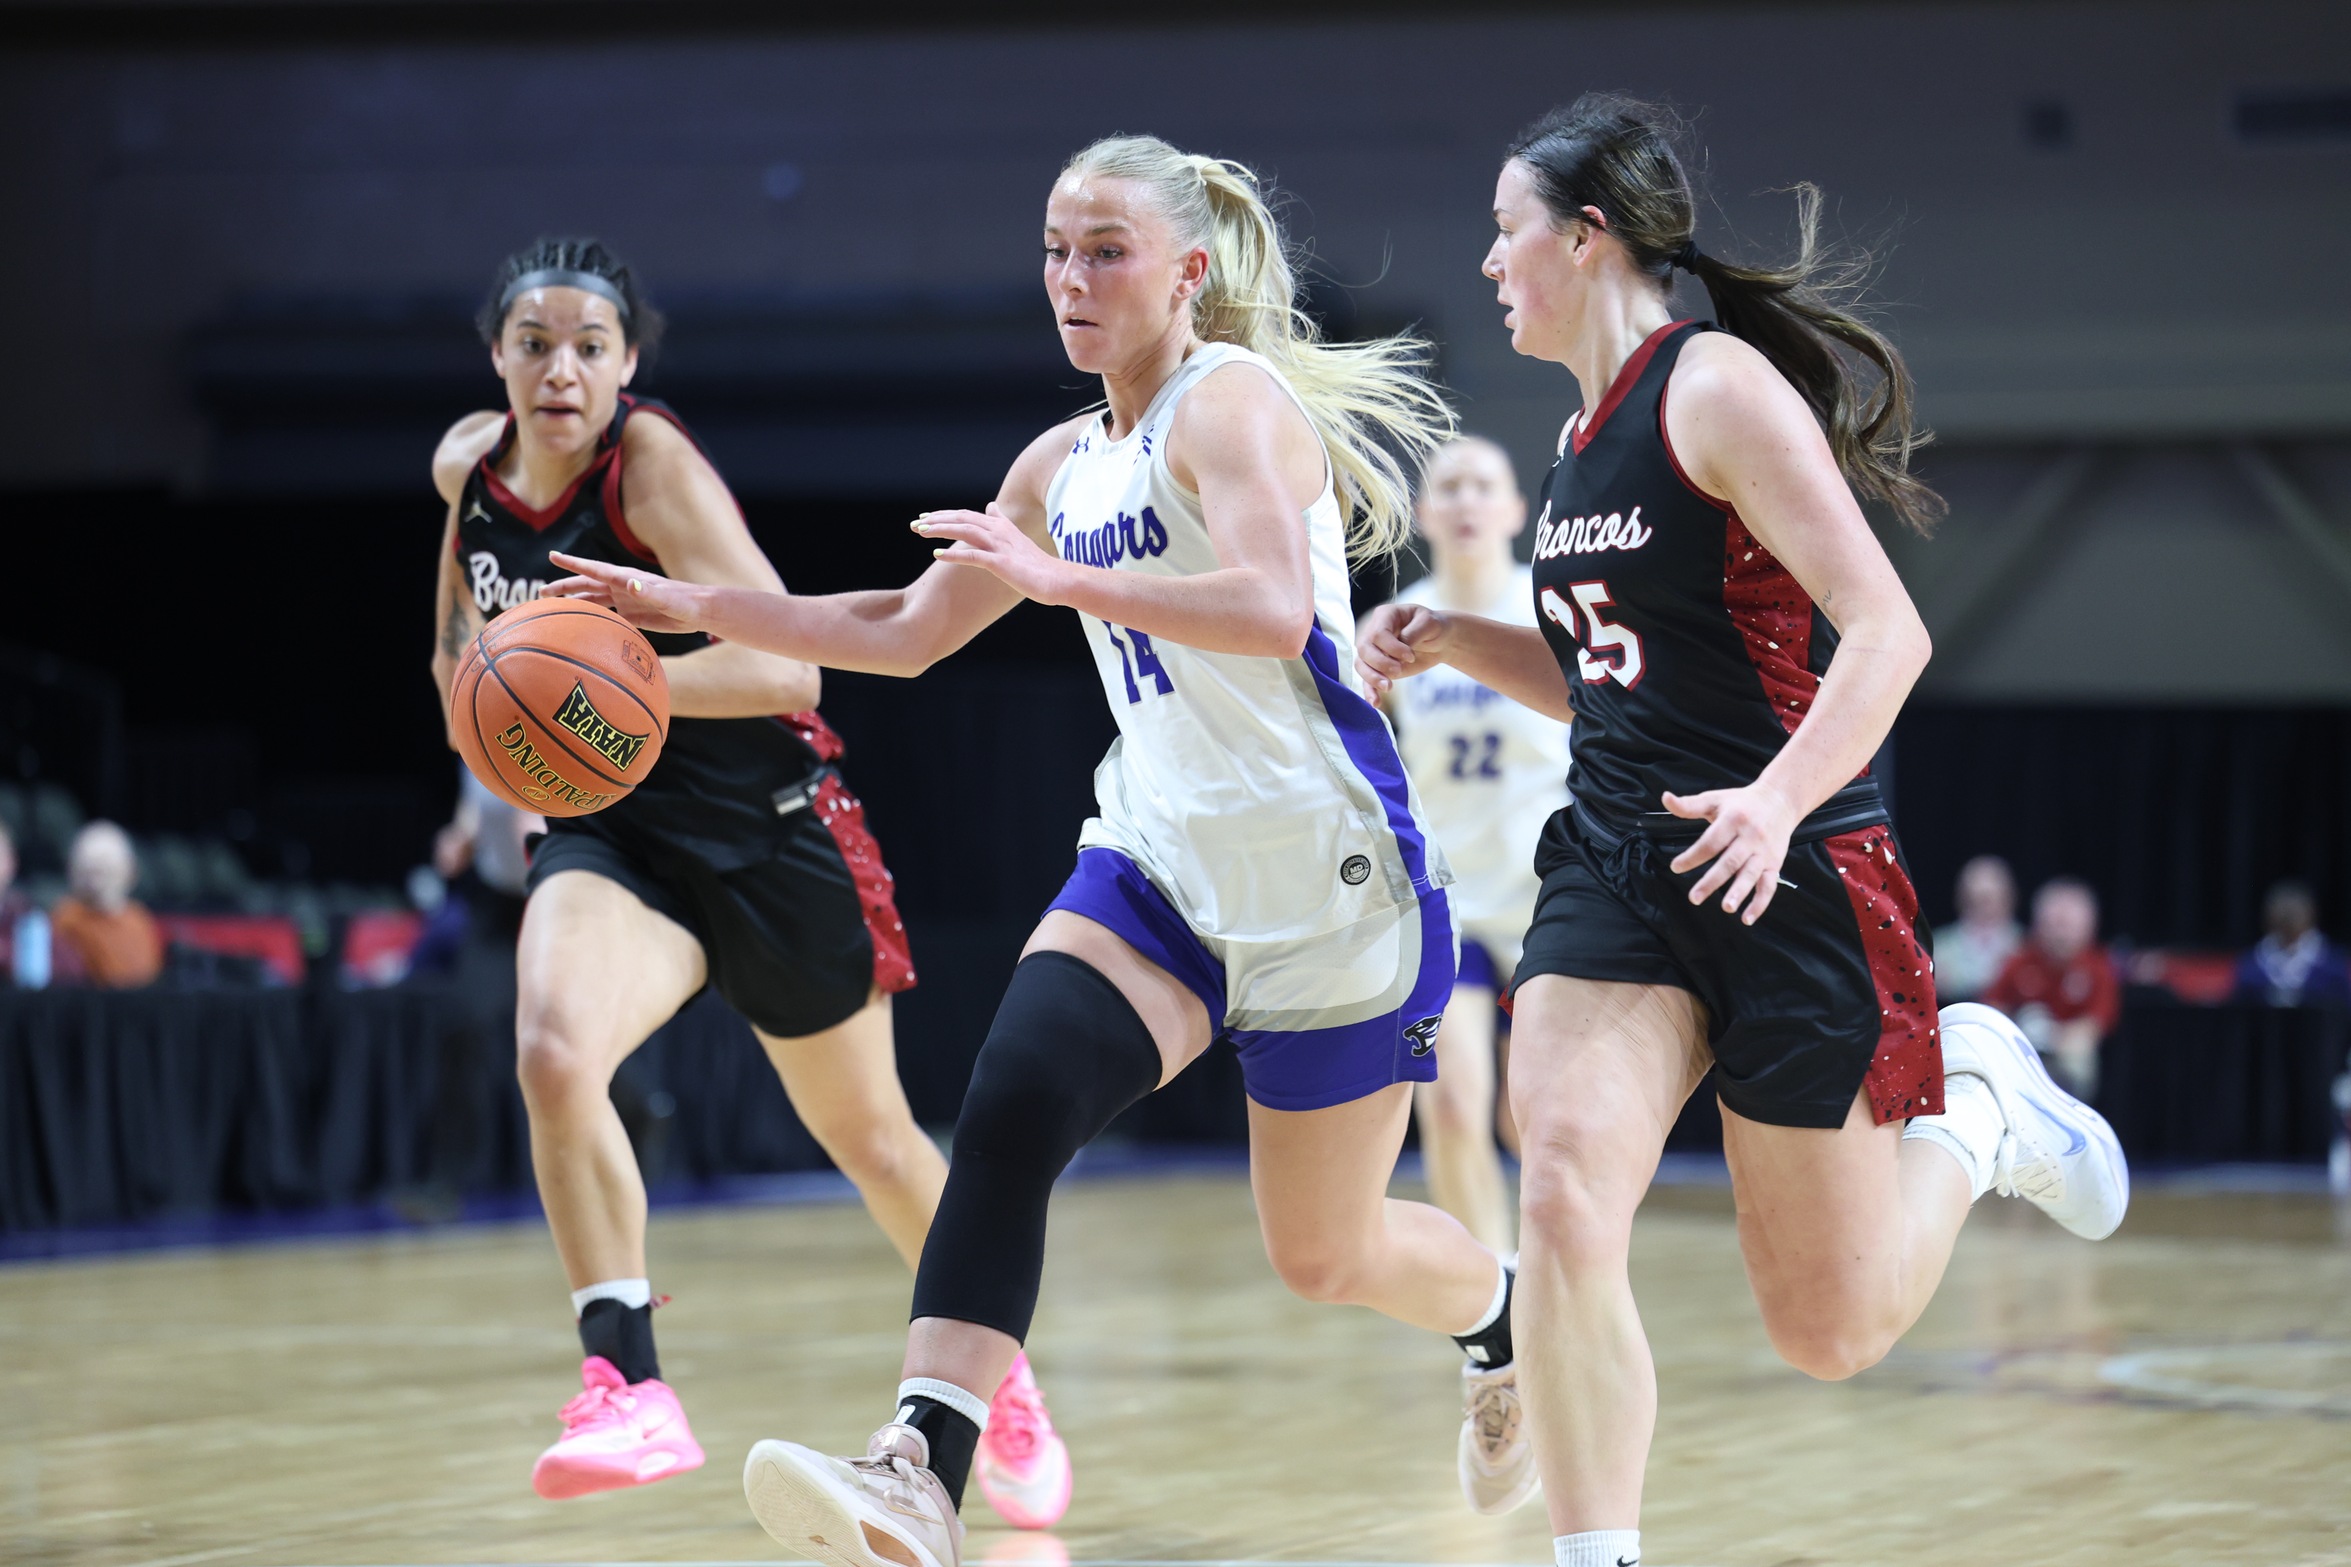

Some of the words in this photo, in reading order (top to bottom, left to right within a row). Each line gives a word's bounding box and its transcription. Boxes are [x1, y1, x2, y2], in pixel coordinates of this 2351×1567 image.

[468, 551, 548, 613] Bron
[1102, 620, 1176, 706] 14
[1540, 579, 1646, 692] 25
[495, 721, 617, 811] SPALDING
[556, 682, 648, 771] NAIA
[1449, 731, 1503, 780] 22
